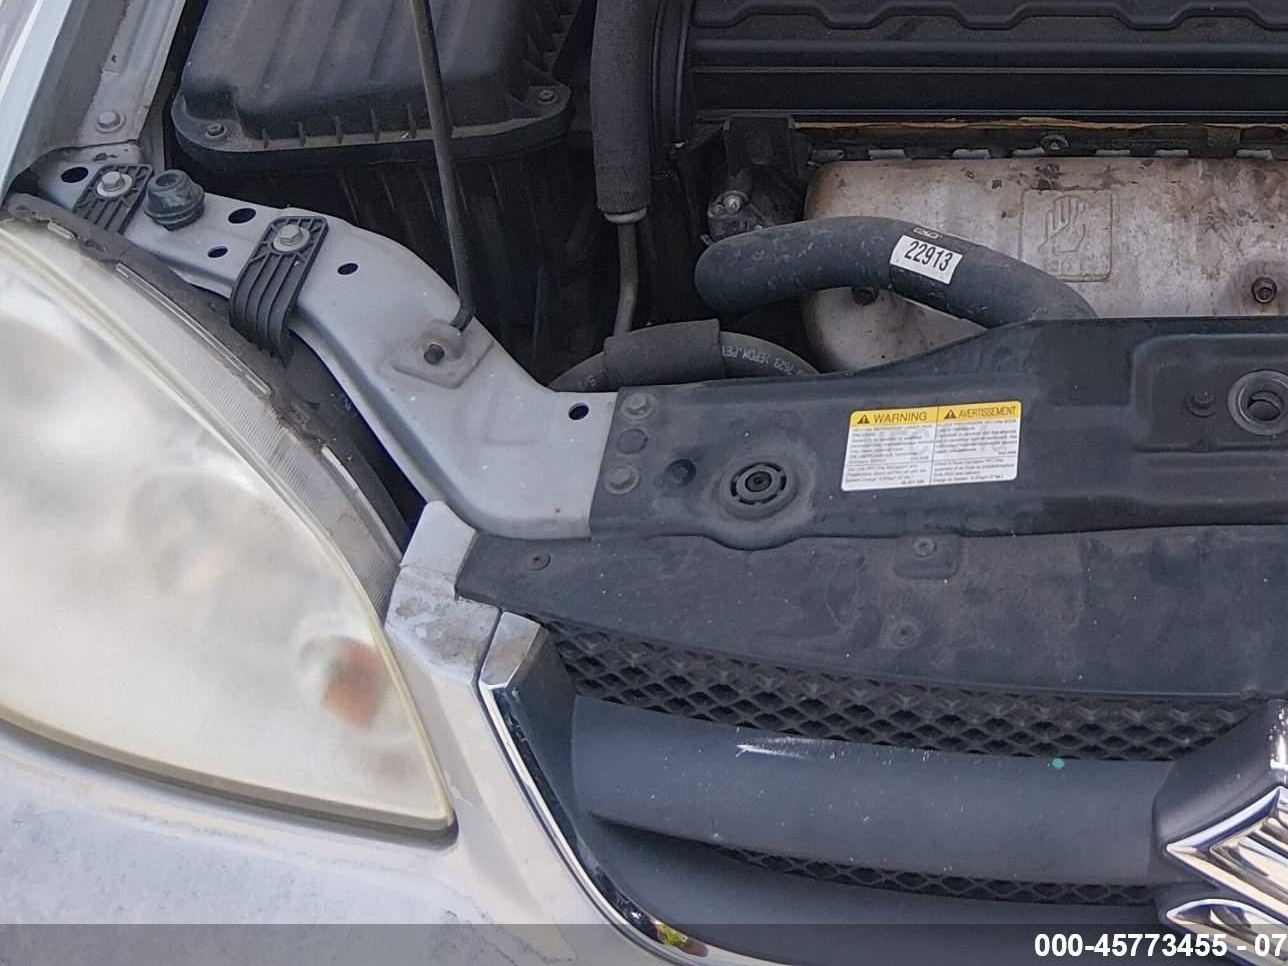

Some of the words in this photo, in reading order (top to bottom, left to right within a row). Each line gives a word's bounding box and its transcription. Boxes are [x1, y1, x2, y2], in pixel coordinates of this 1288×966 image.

[903, 240, 954, 272] 22913
[873, 411, 928, 424] WARNING
[958, 405, 1016, 419] AVERTISSEMENT
